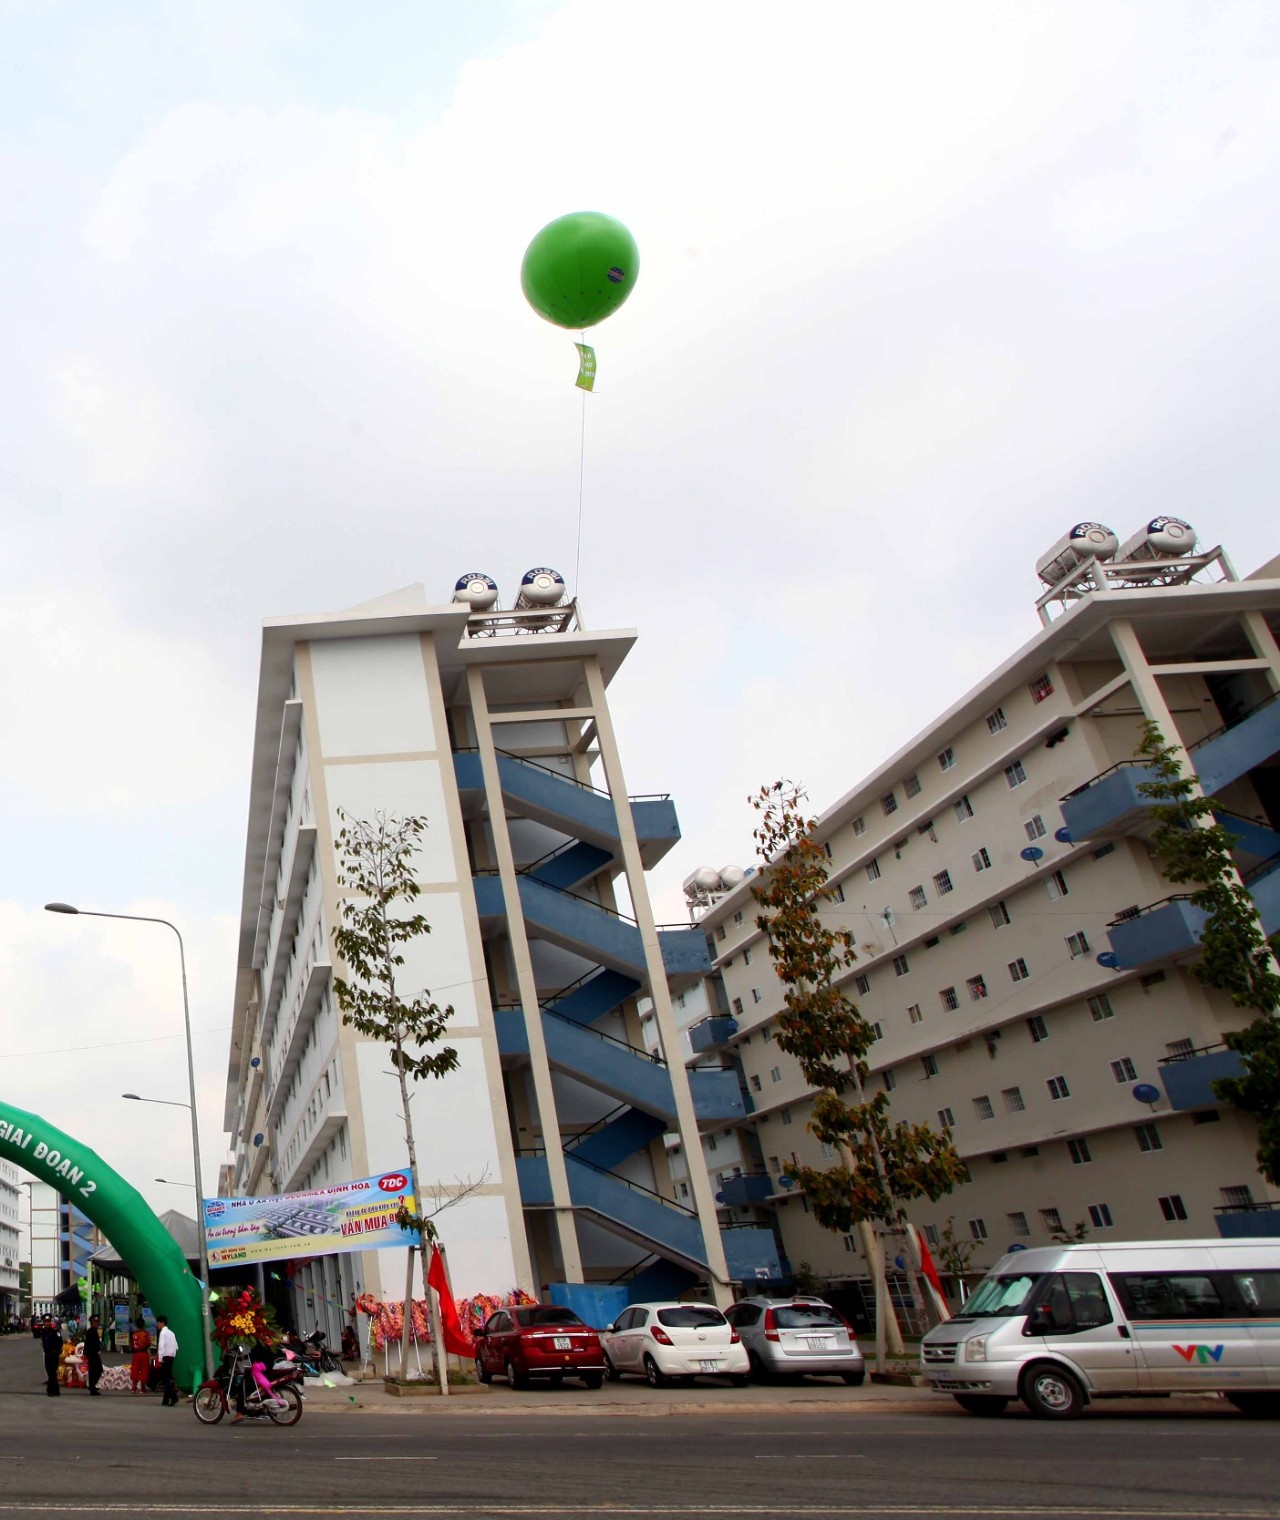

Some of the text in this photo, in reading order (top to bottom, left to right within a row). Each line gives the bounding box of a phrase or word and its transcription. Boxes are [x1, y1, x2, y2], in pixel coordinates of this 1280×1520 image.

[461, 573, 494, 585] ROSSI
[527, 568, 560, 580] ROSSI
[33, 1141, 84, 1186] ĐOẠN
[79, 1180, 97, 1198] 2
[381, 1177, 404, 1189] TDC
[364, 1215, 388, 1232] MUA
[221, 1251, 247, 1260] MYLAND
[1171, 1344, 1224, 1364] VTV
